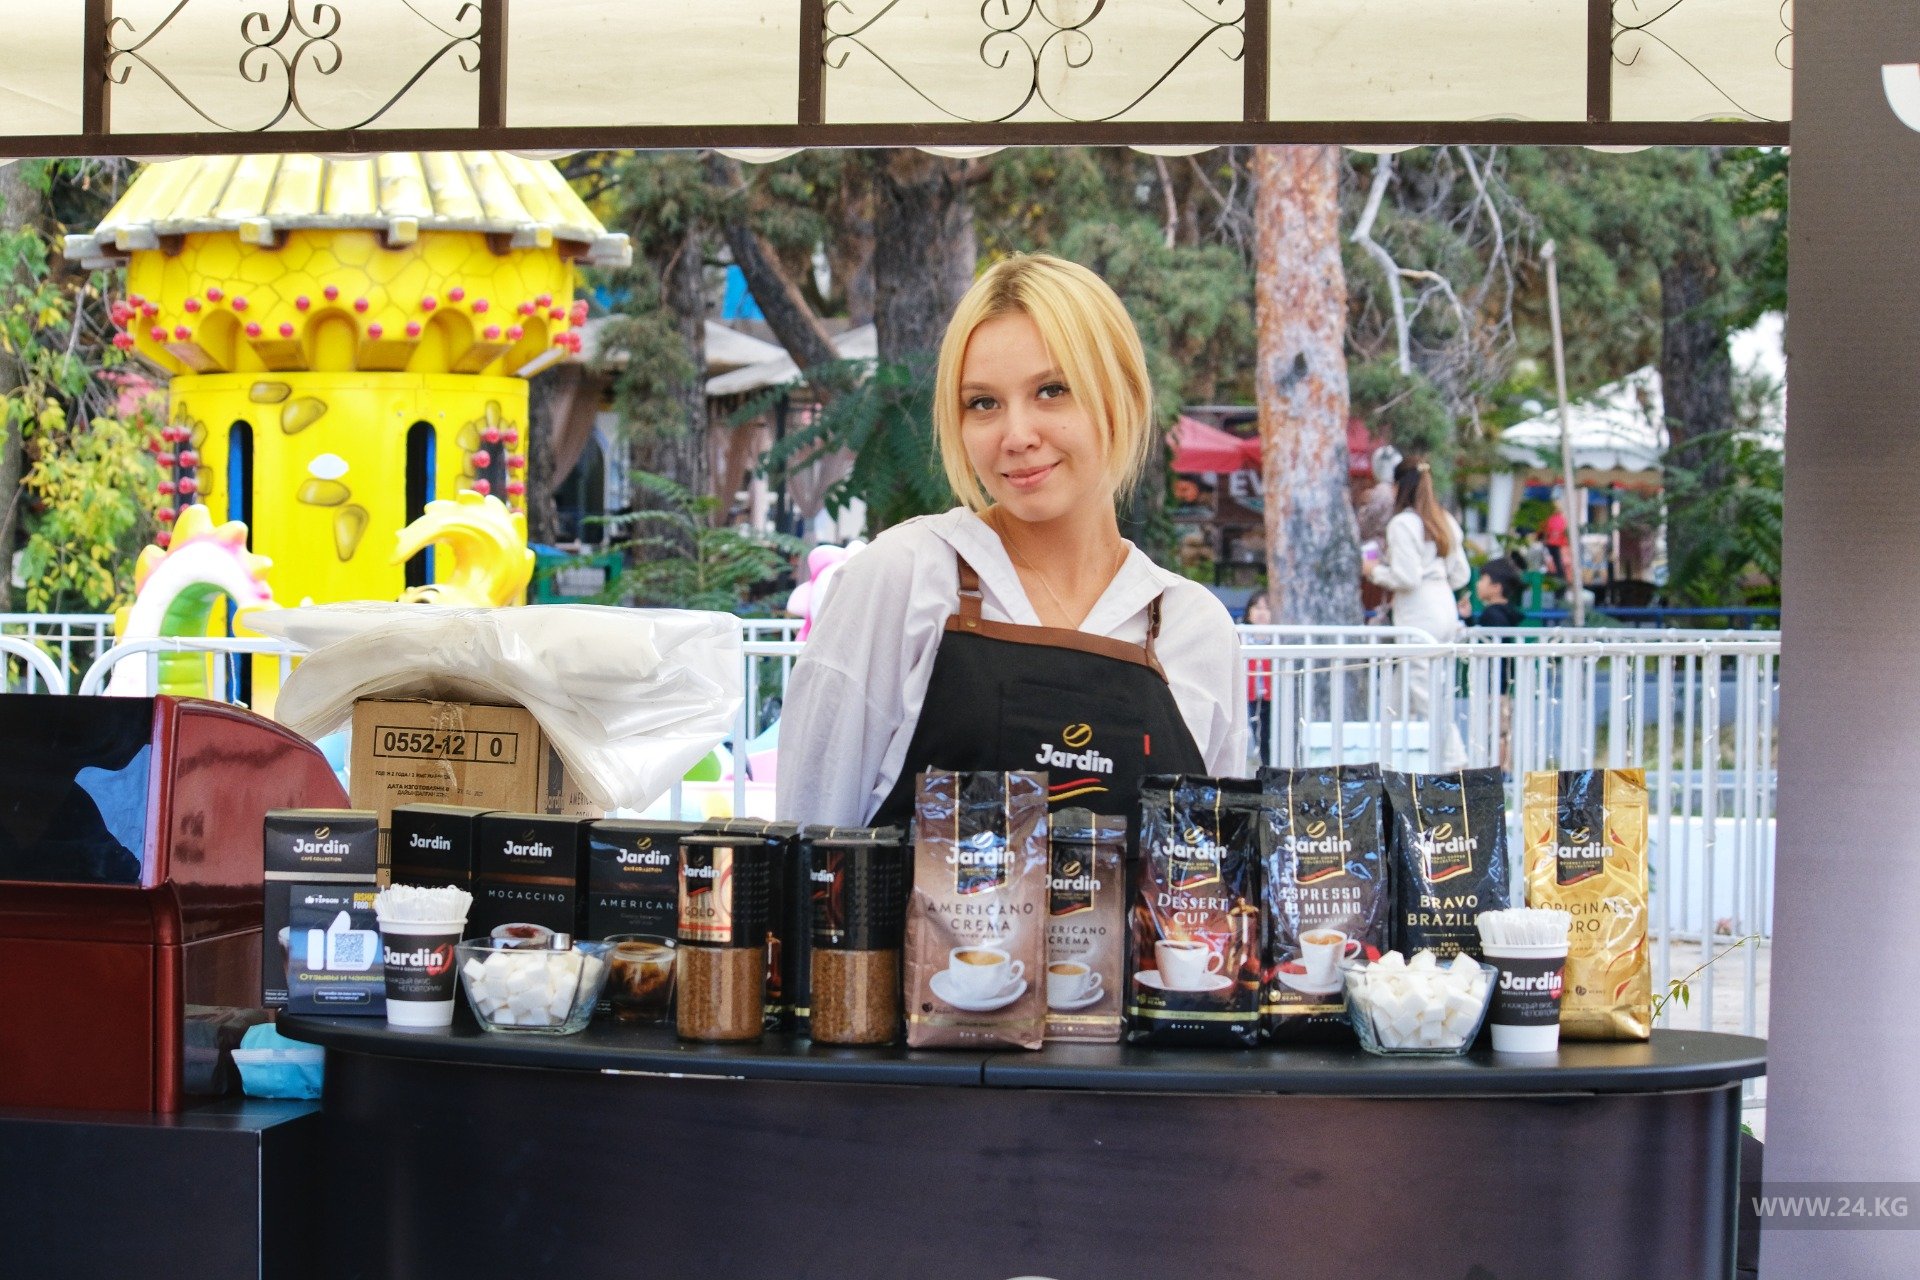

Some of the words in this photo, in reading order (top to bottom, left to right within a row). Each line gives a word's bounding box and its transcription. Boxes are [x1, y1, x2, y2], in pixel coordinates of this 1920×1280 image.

[384, 732, 465, 755] 0552-12
[1035, 743, 1113, 774] Jardin
[293, 839, 350, 855] Jardin
[410, 834, 451, 850] Jardin
[504, 841, 553, 858] Jardin
[1162, 838, 1227, 860] Jardin
[1283, 835, 1352, 854] Jardin
[616, 849, 671, 866] Jardin
[945, 847, 1015, 864] Jardin
[1547, 842, 1614, 859] Jardin
[683, 864, 720, 878] Jardin
[810, 869, 834, 882] ardin
[1045, 874, 1101, 891] Jardin
[488, 890, 565, 902] MOCACCINO
[1280, 887, 1361, 901] ESPRESSO
[600, 899, 674, 910] AMERICAN
[928, 902, 1034, 915] AMERICANO
[1157, 893, 1229, 912] DESSERT
[1304, 902, 1361, 916] MILANO
[1420, 895, 1478, 909] BRAVO
[685, 906, 715, 918] GOLD
[1173, 911, 1209, 926] CUP
[951, 918, 1010, 932] CREMA
[1048, 926, 1106, 936] ERICANO
[1568, 919, 1600, 933] RO
[1048, 936, 1090, 946] CREMA
[384, 946, 443, 966] Jardin
[300, 973, 339, 981] Отзывы
[1500, 971, 1562, 990] Jardin
